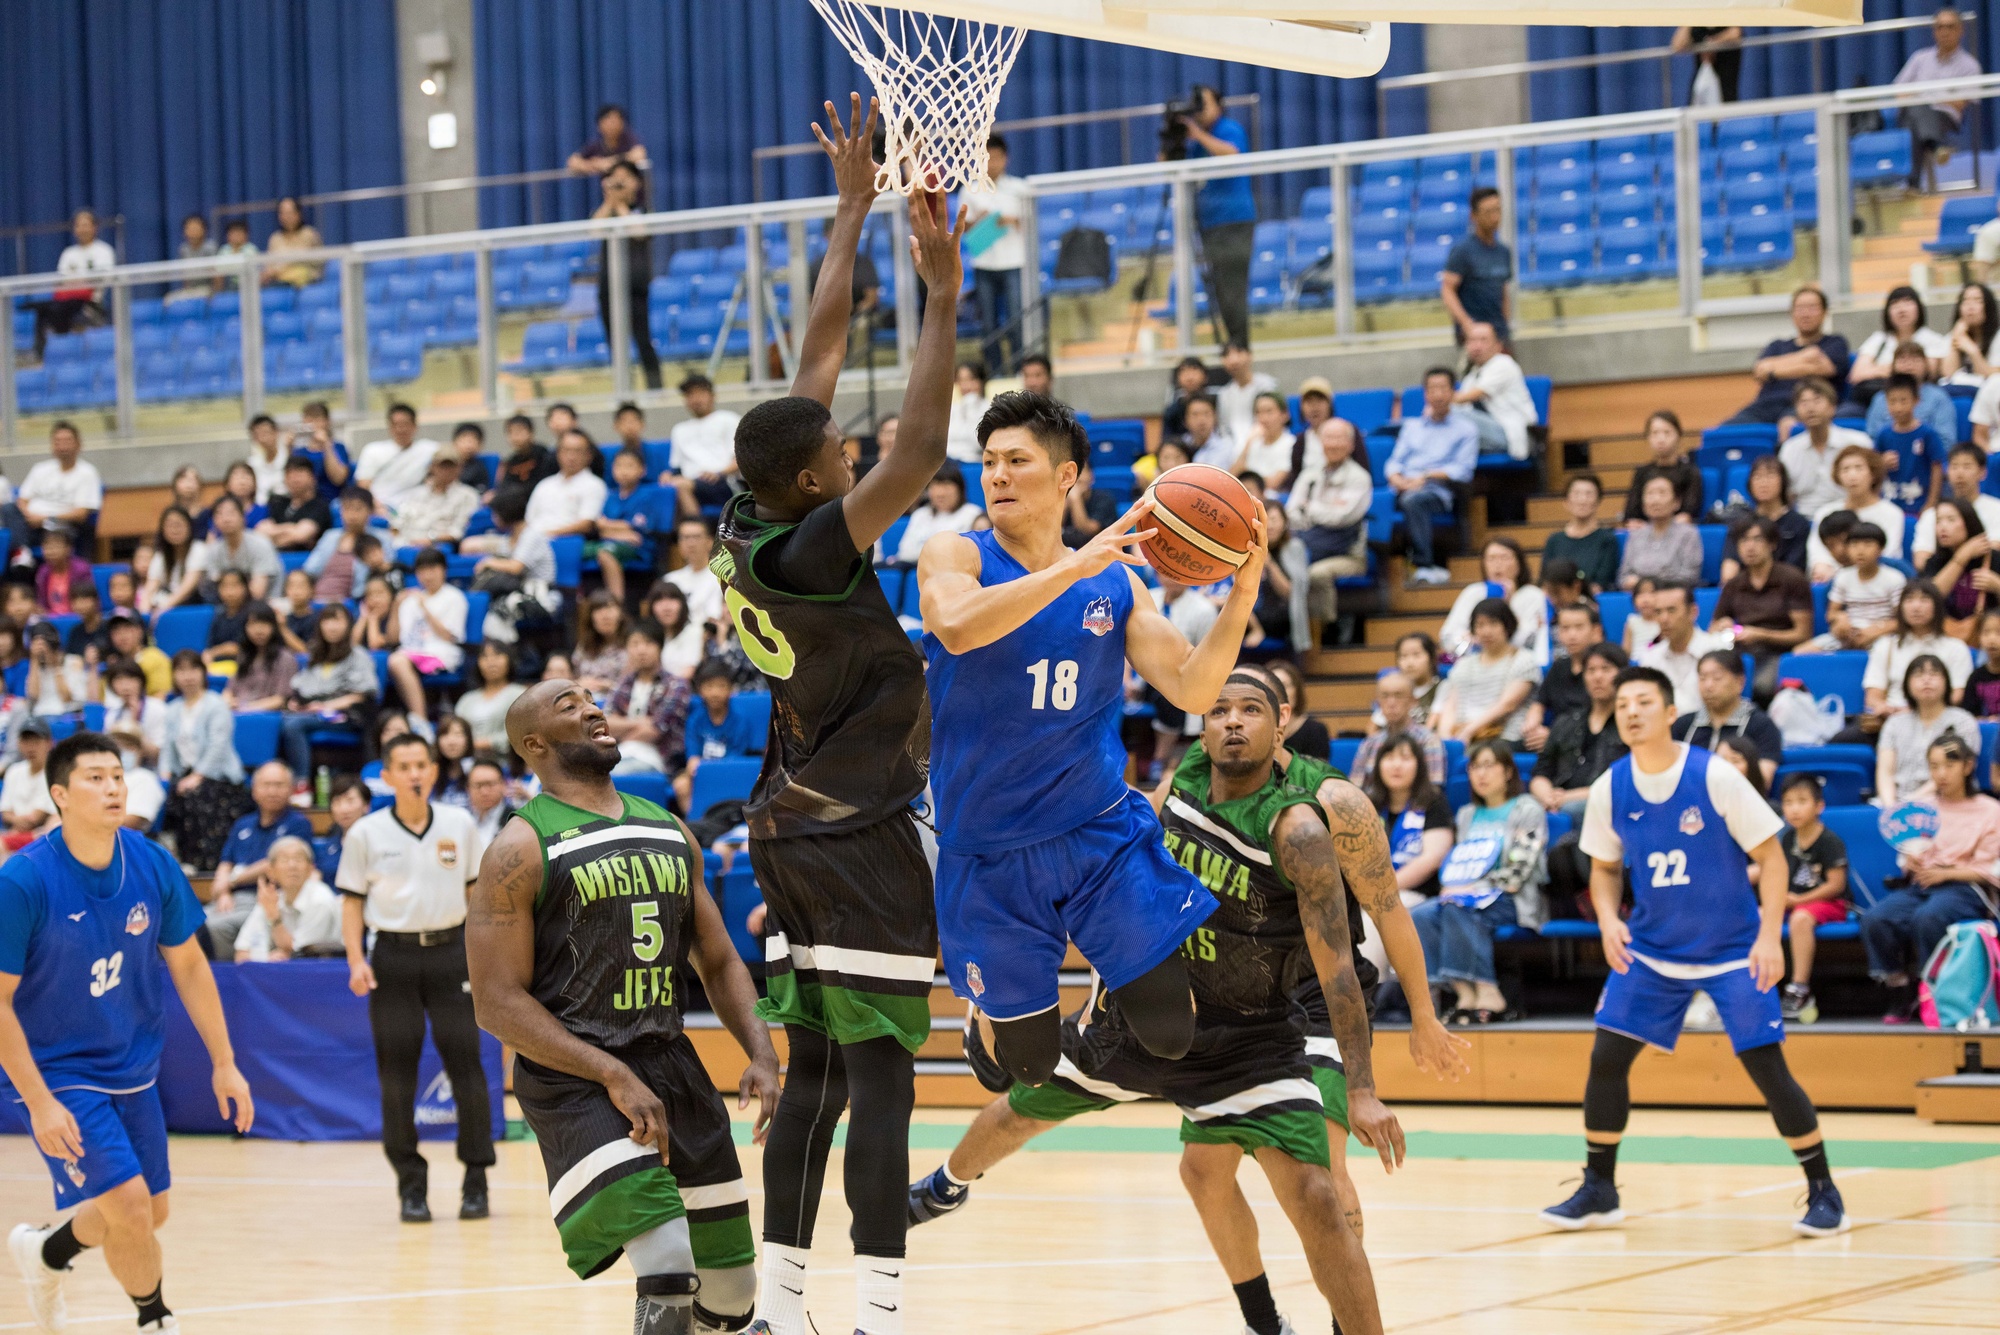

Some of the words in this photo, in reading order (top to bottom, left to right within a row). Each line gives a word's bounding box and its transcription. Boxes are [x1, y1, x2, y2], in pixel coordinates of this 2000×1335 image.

[1190, 498, 1218, 522] JBA
[1152, 533, 1214, 575] molten
[724, 585, 796, 680] 0
[1026, 658, 1079, 711] 18
[570, 854, 689, 907] MISAWA
[1646, 848, 1691, 888] 22
[631, 901, 664, 962] 5
[90, 950, 124, 998] 32
[613, 965, 673, 1010] JETS
